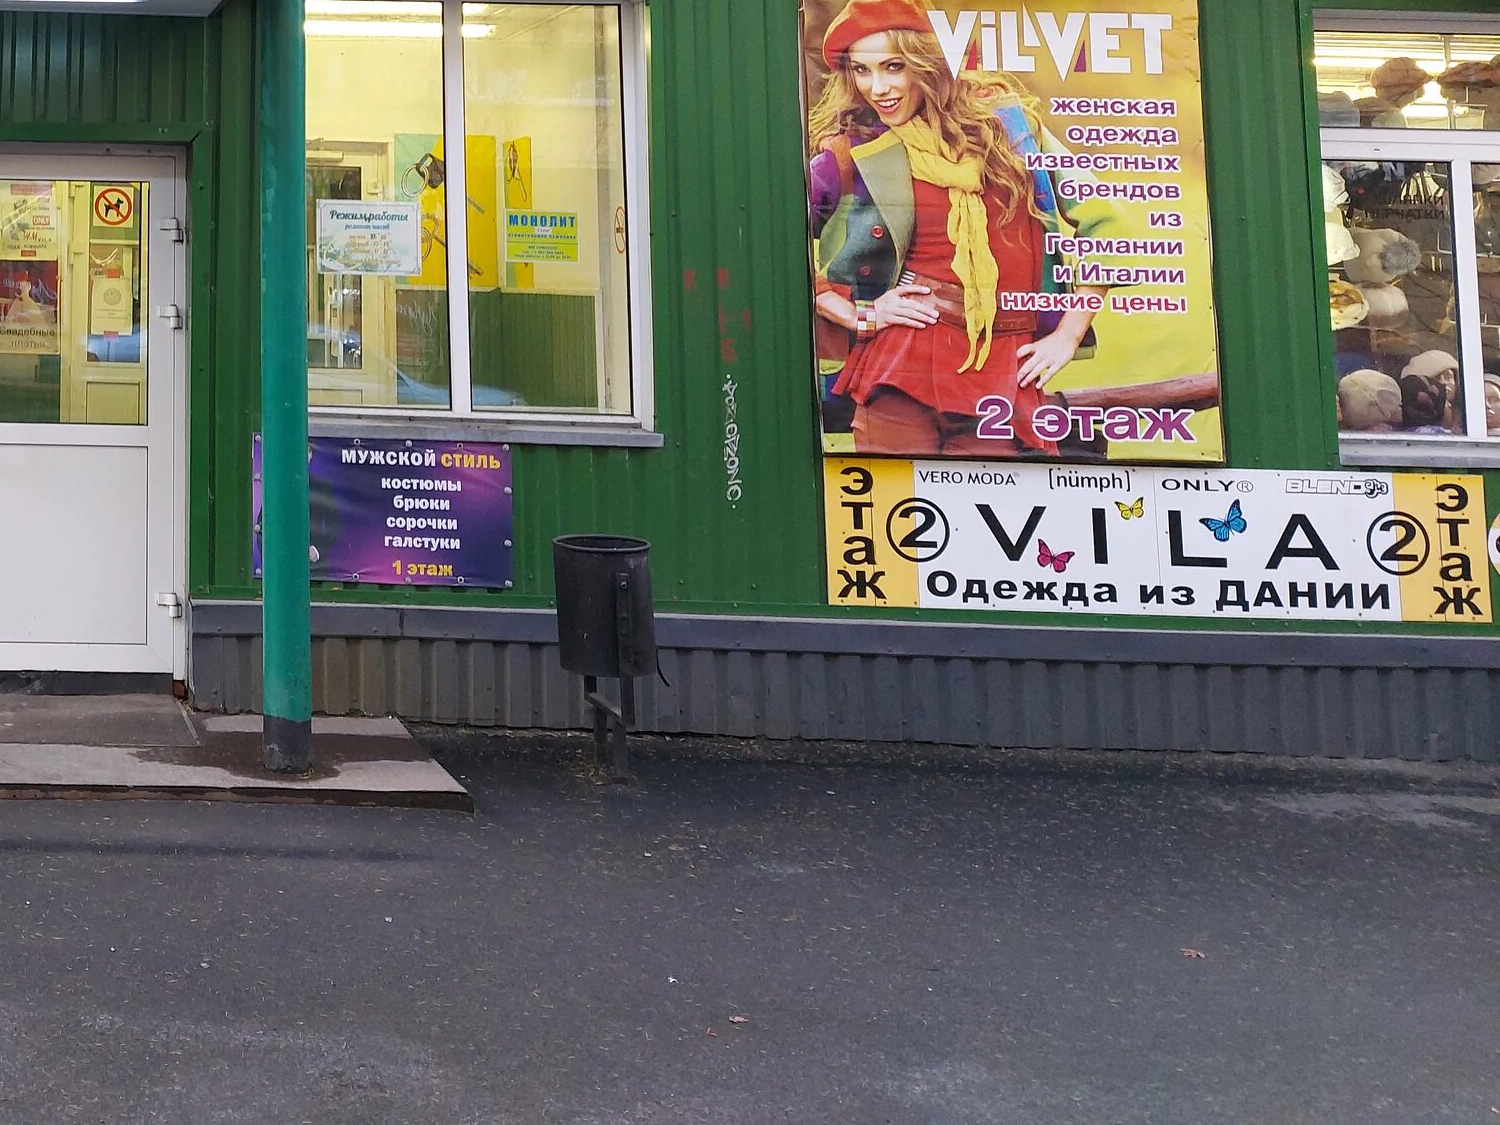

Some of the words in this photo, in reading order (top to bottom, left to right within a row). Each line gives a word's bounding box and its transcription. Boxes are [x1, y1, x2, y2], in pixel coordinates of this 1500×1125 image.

[1050, 97, 1177, 117] женская
[1067, 126, 1179, 146] одежда
[1026, 152, 1181, 172] известных
[1059, 179, 1182, 201] брендов
[509, 214, 575, 227] МОНОЛИТ
[1149, 211, 1182, 227] из
[1045, 235, 1184, 256] Германии
[1055, 268, 1072, 283] и
[1080, 264, 1185, 284] Италии
[1001, 292, 1103, 311] низкие
[1112, 294, 1188, 315] цены
[976, 396, 1014, 439] 2
[1032, 406, 1197, 443] этаж
[341, 448, 436, 467] МУЖСКОЙ
[381, 477, 461, 491] костюмы
[918, 470, 963, 484] VERO
[393, 495, 450, 511] брюки
[386, 516, 458, 531] сорочки
[384, 535, 461, 552] галстуки
[392, 560, 402, 575] 1
[407, 563, 453, 576] этаж
[926, 570, 1119, 607] Одежда
[1139, 583, 1196, 606] из
[1215, 580, 1390, 612] ДАНИИ
